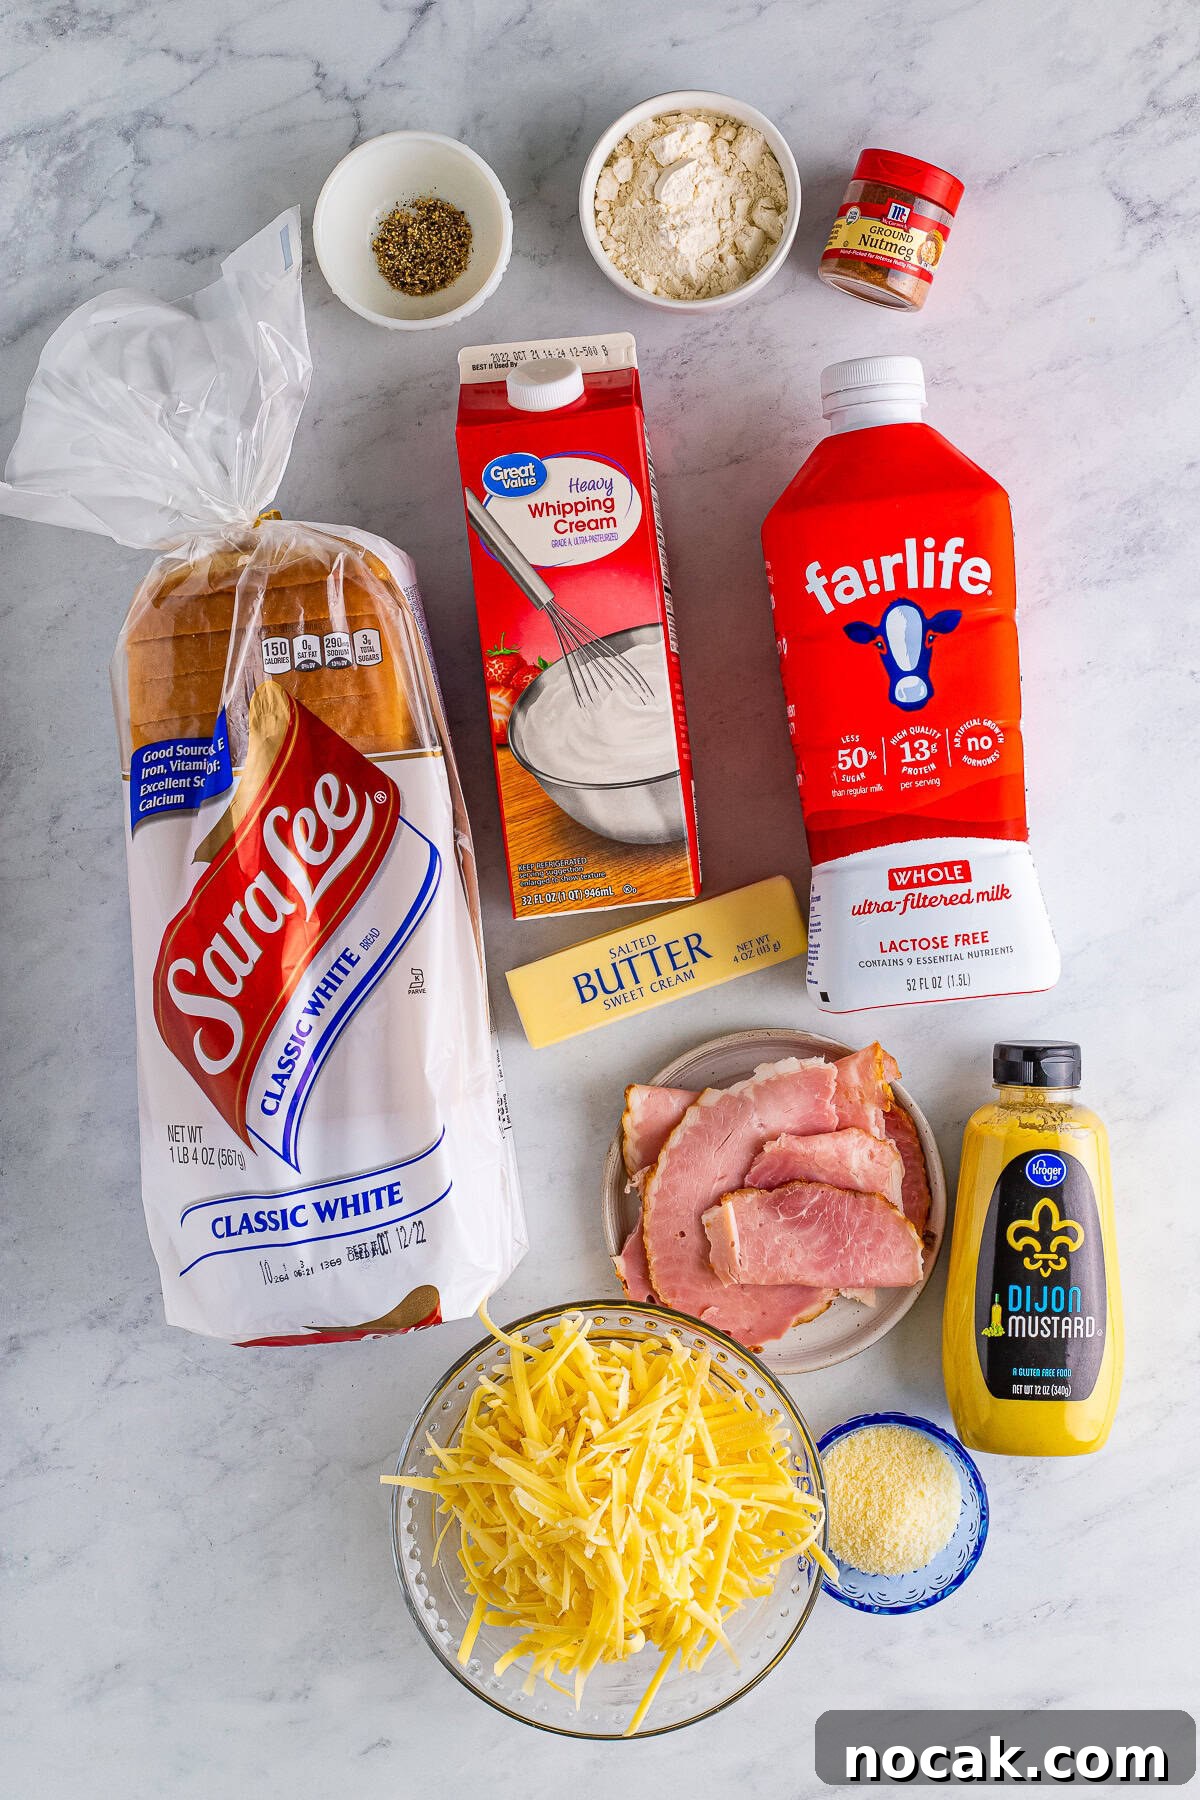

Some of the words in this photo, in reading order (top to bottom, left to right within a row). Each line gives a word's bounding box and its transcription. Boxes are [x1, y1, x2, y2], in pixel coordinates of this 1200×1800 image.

[870, 226, 914, 243] GROUND
[858, 234, 914, 262] Nutmeg
[490, 352, 510, 363] 2022
[513, 350, 527, 360] OCT
[530, 349, 540, 360] 21
[490, 462, 536, 481] Great
[502, 477, 536, 489] Value
[568, 478, 614, 496] Heavy
[528, 496, 615, 518] Whipping
[554, 516, 617, 534] Cream
[552, 538, 568, 548] GRADE
[264, 641, 287, 656] 150
[302, 640, 312, 650] 0g
[362, 634, 372, 645] 3g
[298, 651, 308, 659] SAT
[308, 650, 318, 658] FAT
[358, 654, 380, 662] SUGARS
[360, 646, 376, 654] TOTAL
[264, 656, 290, 665] CALORIES
[840, 734, 860, 744] LESS
[890, 729, 908, 746] HIGH
[908, 726, 942, 740] QUALITY
[954, 718, 982, 748] ARTIFICIAL
[982, 718, 1005, 744] GROWTH
[900, 740, 938, 764] 13g
[967, 736, 992, 752] no
[142, 746, 174, 764] Good
[838, 746, 877, 770] 50%
[141, 764, 167, 780] Iron,
[841, 772, 866, 782] SUGAR
[901, 762, 937, 776] PROTEIN
[140, 778, 191, 796] Excellent
[832, 788, 846, 798] than
[846, 786, 868, 797] regular
[870, 784, 884, 793] milk
[900, 781, 912, 791] per
[914, 778, 940, 788] serving
[139, 794, 184, 812] Calcium
[518, 864, 534, 872] KEEP
[536, 857, 588, 870] REFRIGERATED
[519, 870, 544, 879] serving
[546, 866, 584, 876] suggestion
[520, 878, 550, 888] enlarged
[580, 871, 606, 880] texture
[892, 864, 964, 886] WHOLE
[522, 896, 532, 906] 32
[534, 894, 544, 905] FL
[545, 892, 556, 902] OZ
[558, 892, 566, 904] (1
[568, 890, 583, 900] QT)
[584, 886, 614, 898] 946mL
[851, 888, 974, 916] ultra-filtered
[976, 884, 1012, 904] milk
[167, 871, 296, 1075] Sara
[263, 773, 374, 922] Lee
[608, 934, 658, 960] SALTED
[736, 938, 756, 952] NET
[756, 934, 770, 945] WT
[879, 936, 950, 954] LACTOSE
[954, 930, 990, 948] FREE
[733, 954, 740, 964] 4
[756, 943, 771, 958] (113
[858, 958, 904, 968] CONTAINS
[906, 958, 913, 966] 9
[916, 953, 964, 966] ESSENTIAL
[967, 946, 1014, 959] NUTRIENTS
[573, 932, 712, 1004] BUTTER
[603, 986, 644, 1011] SWEET
[650, 970, 696, 993] CREAM
[906, 978, 916, 991] 52
[920, 977, 930, 990] FL
[932, 976, 942, 988] OZ
[948, 973, 971, 988] (1.5L)
[260, 1019, 313, 1117] CLASSIC
[302, 946, 361, 1018] WHITE
[360, 927, 380, 952] BREAD
[168, 1124, 185, 1143] NET
[187, 1126, 203, 1144] WT
[170, 1146, 175, 1163] 1
[177, 1146, 189, 1164] LB
[192, 1147, 198, 1164] 4
[201, 1147, 215, 1165] OZ
[218, 1148, 246, 1171] (567g)
[1032, 1160, 1062, 1182] Kroger
[211, 1204, 308, 1240] CLASSIC
[312, 1180, 404, 1224] WHITE
[396, 1220, 426, 1250] 12/22
[320, 1258, 342, 1270] 1369
[1008, 1284, 1082, 1312] DIJON
[1008, 1316, 1096, 1338] MUSTARD
[1012, 1368, 1018, 1376] A
[1018, 1368, 1040, 1377] GLUTEN
[1042, 1368, 1056, 1377] FREE
[1056, 1368, 1072, 1377] FOOD
[1012, 1384, 1023, 1395] NET
[1024, 1384, 1034, 1395] WT
[1034, 1385, 1042, 1395] 12
[1042, 1385, 1050, 1396] OZ
[1051, 1384, 1072, 1398] (340g)
